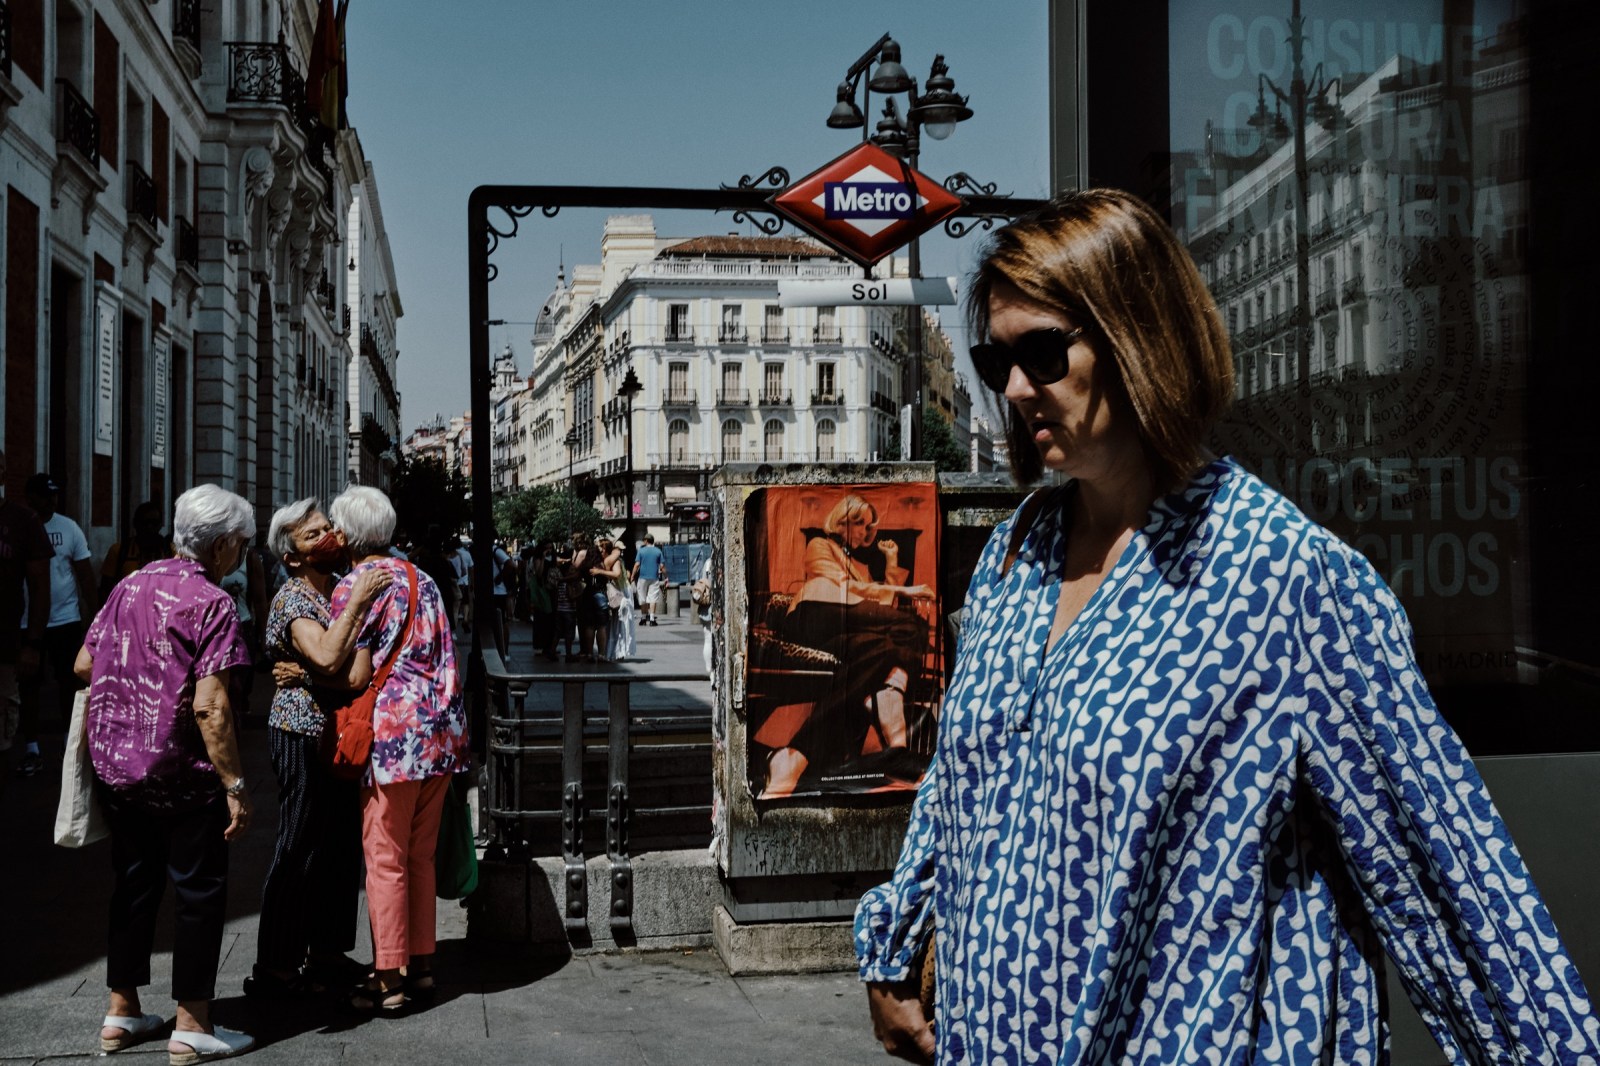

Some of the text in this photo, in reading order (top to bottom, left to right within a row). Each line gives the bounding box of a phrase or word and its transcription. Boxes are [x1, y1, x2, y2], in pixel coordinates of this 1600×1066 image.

[1207, 13, 1482, 86] CONSUME
[833, 187, 912, 212] Metro
[1185, 168, 1506, 237] FINANCIERA
[1372, 232, 1441, 286] ejercicio
[1458, 249, 1479, 277] de
[852, 284, 887, 300] Sol
[1445, 271, 1459, 284] y
[1444, 326, 1458, 367] más
[1469, 279, 1496, 403] prestaciones
[1427, 288, 1475, 442] correspondiente
[1486, 316, 1513, 421] ponderada
[1334, 386, 1362, 405] los
[1370, 355, 1435, 425] ocurridos
[1430, 372, 1454, 401] los
[1235, 397, 1272, 448] curso
[1312, 397, 1337, 424] los
[1345, 413, 1366, 424] en
[1387, 397, 1437, 441] pagos
[1464, 406, 1481, 425] al
[1467, 422, 1492, 454] por
[1438, 652, 1518, 669] MADRID
